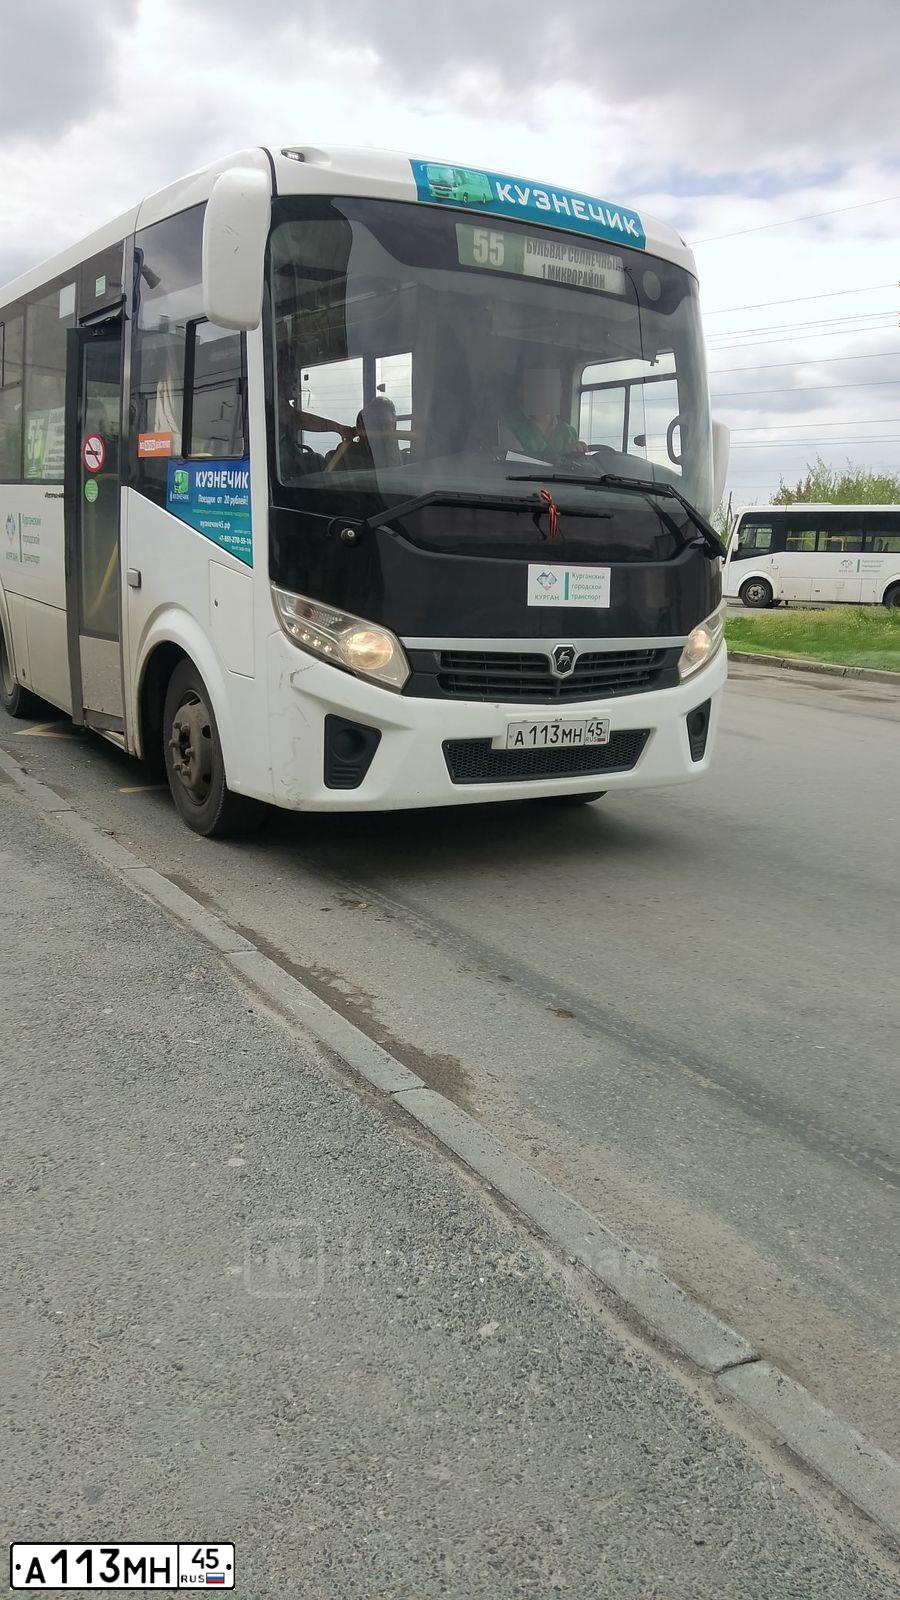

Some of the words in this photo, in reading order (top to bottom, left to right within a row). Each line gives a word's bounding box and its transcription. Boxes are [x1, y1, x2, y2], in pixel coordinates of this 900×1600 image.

[495, 181, 640, 238] КУЗНЕЧИК
[472, 228, 505, 266] 55
[526, 239, 567, 261] БУЛЬВАР
[541, 264, 547, 279] 1
[547, 264, 606, 290] МИКРОРАЙОН
[27, 418, 44, 460] 55
[195, 470, 249, 489] КУЗНЕЧИК
[571, 572, 605, 580] Курганский
[587, 721, 604, 737] 45
